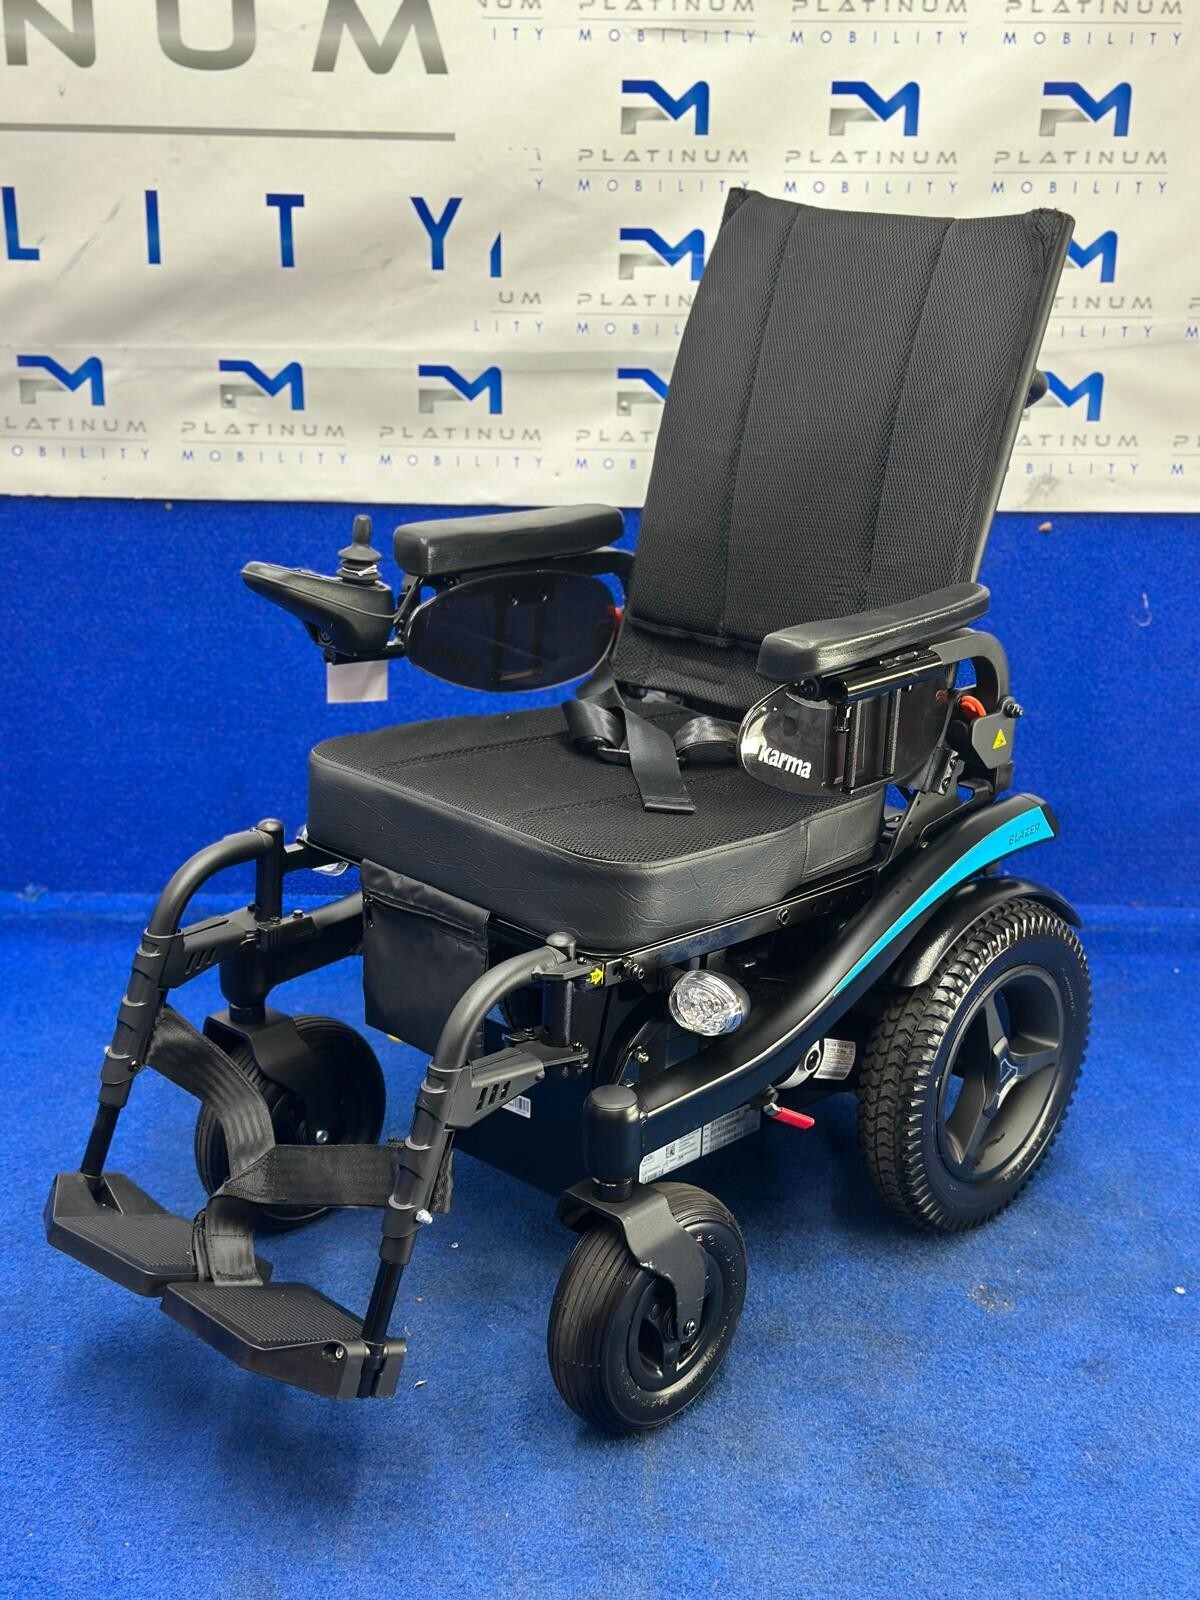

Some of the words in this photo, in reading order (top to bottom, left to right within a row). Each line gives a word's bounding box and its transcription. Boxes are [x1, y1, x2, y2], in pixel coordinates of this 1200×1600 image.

[579, 0, 755, 12] PLATINUM
[792, 0, 968, 14] PLATINUM
[1005, 0, 1183, 15] PLATINUM
[578, 28, 757, 43] MOBILITY
[789, 30, 968, 45] MOBILITY
[1003, 31, 1182, 46] MOBILITY
[578, 149, 749, 163] PLATINUM
[784, 150, 958, 165] PLATINUM
[993, 150, 1168, 165] PLATINUM
[577, 179, 750, 192] MOBILITY
[783, 180, 959, 194] MOBILITY
[991, 181, 1168, 195] MOBILITY
[181, 422, 345, 437] PLATINUM
[379, 425, 542, 441] PLATINUM
[181, 450, 347, 464] MOBILITY
[379, 454, 542, 468] MOBILITY
[758, 742, 812, 779] karma
[1009, 823, 1040, 846] BLAZER
